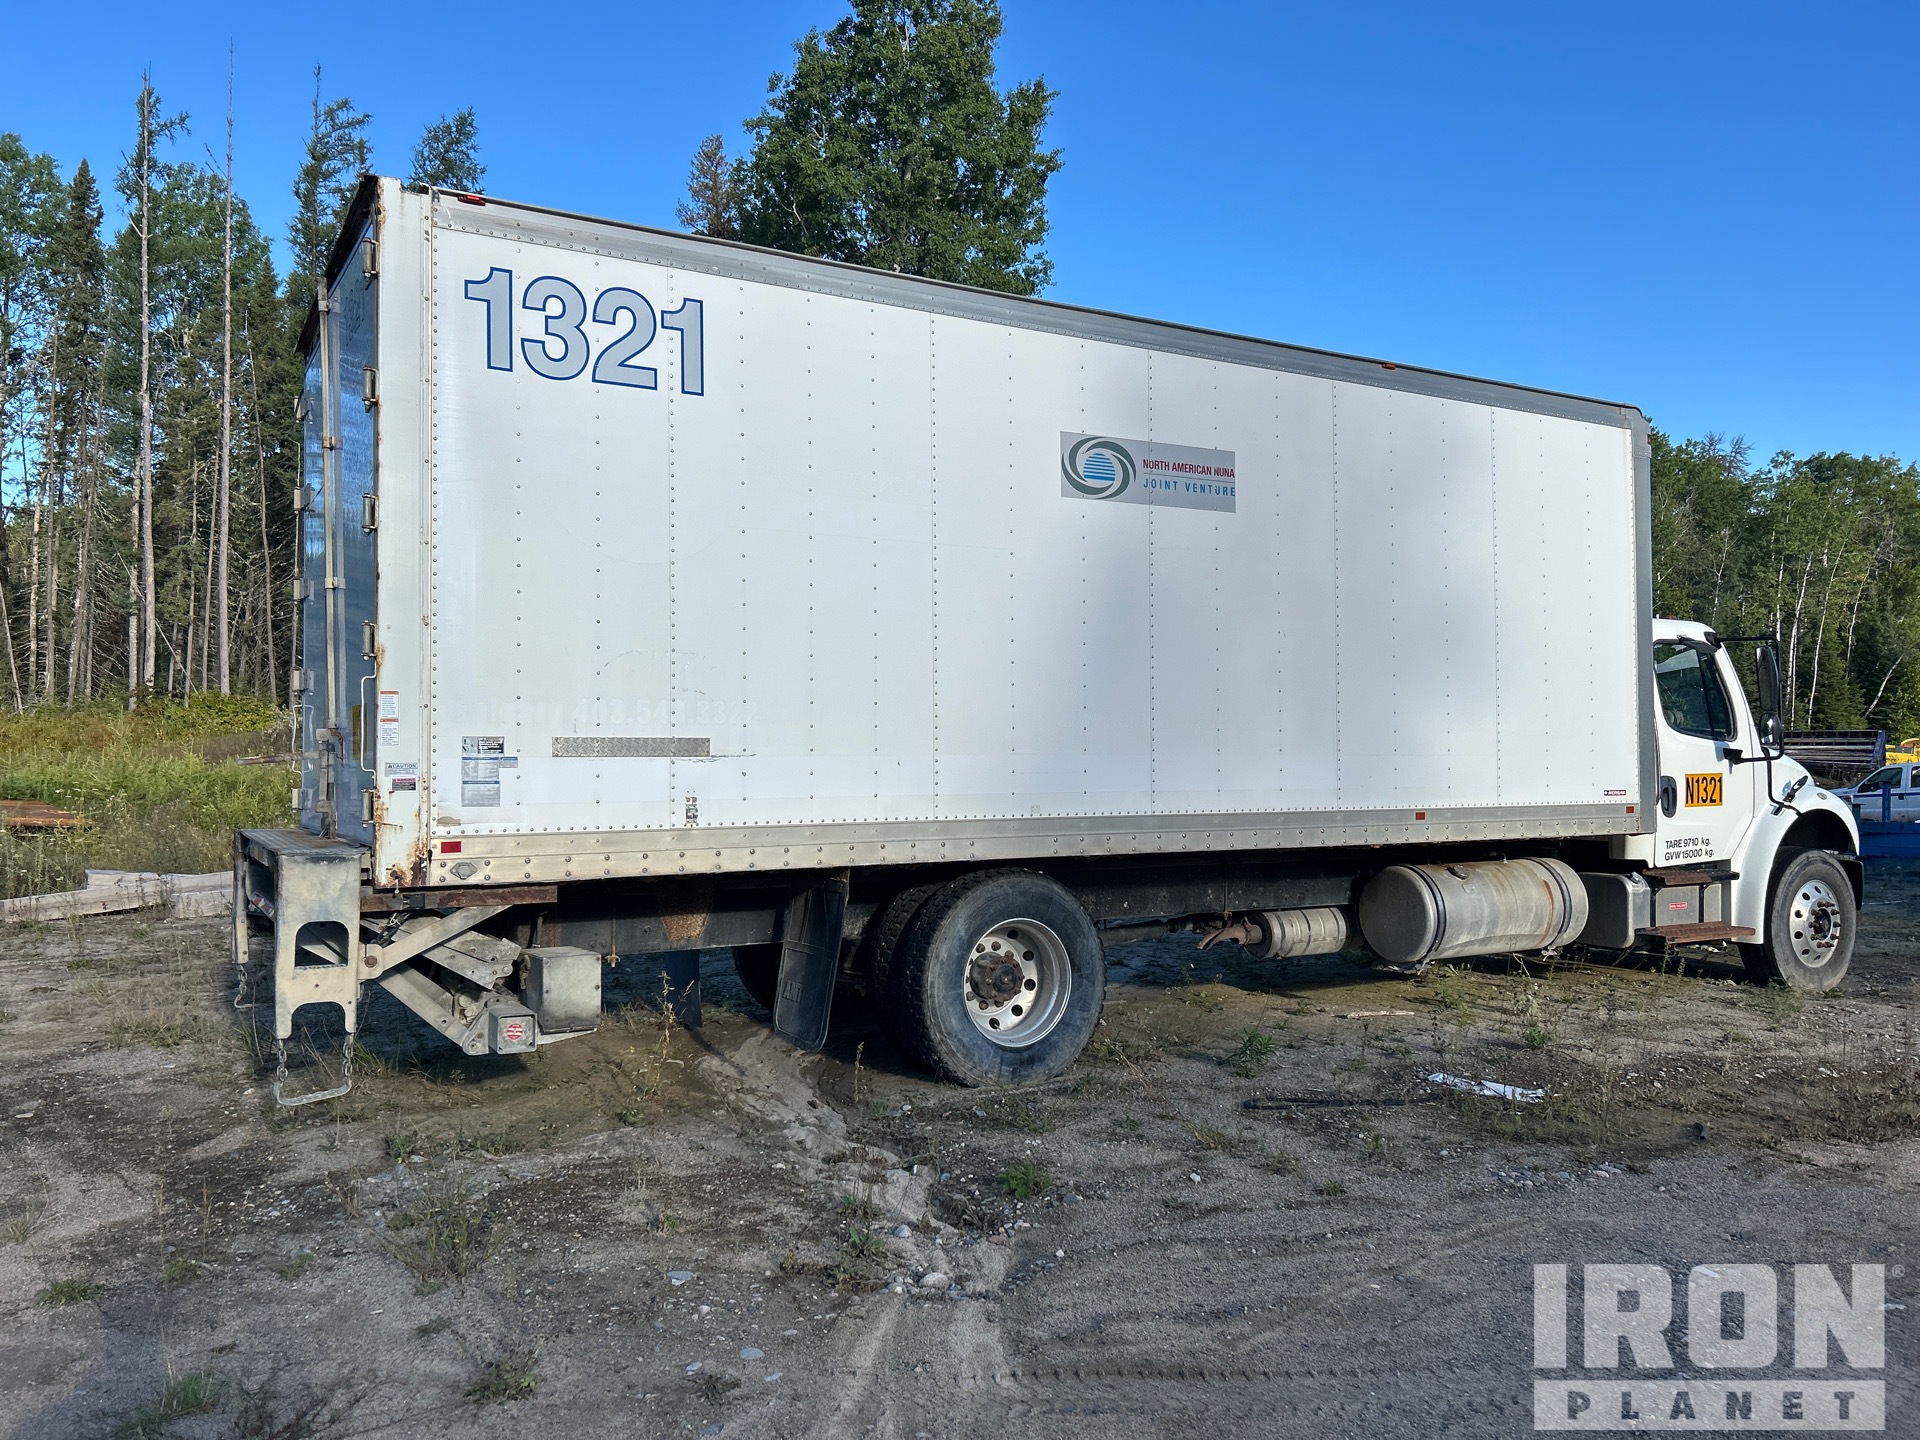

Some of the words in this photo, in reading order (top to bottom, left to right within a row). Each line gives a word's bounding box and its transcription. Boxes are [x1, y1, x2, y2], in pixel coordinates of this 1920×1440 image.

[464, 266, 704, 396] 1321
[1142, 459, 1170, 471] NORTH
[1171, 462, 1213, 475] AMERICAN
[1213, 467, 1235, 478] NUNA
[1143, 479, 1178, 491] JOINT
[1185, 482, 1236, 497] VENTURE
[1685, 776, 1723, 804] N1321
[1665, 839, 1683, 849] TARE
[1683, 837, 1699, 848] 9710
[1701, 837, 1711, 847] kg.
[1664, 851, 1682, 861] GVW
[1682, 848, 1703, 859] 15000
[1705, 848, 1715, 858] kg.
